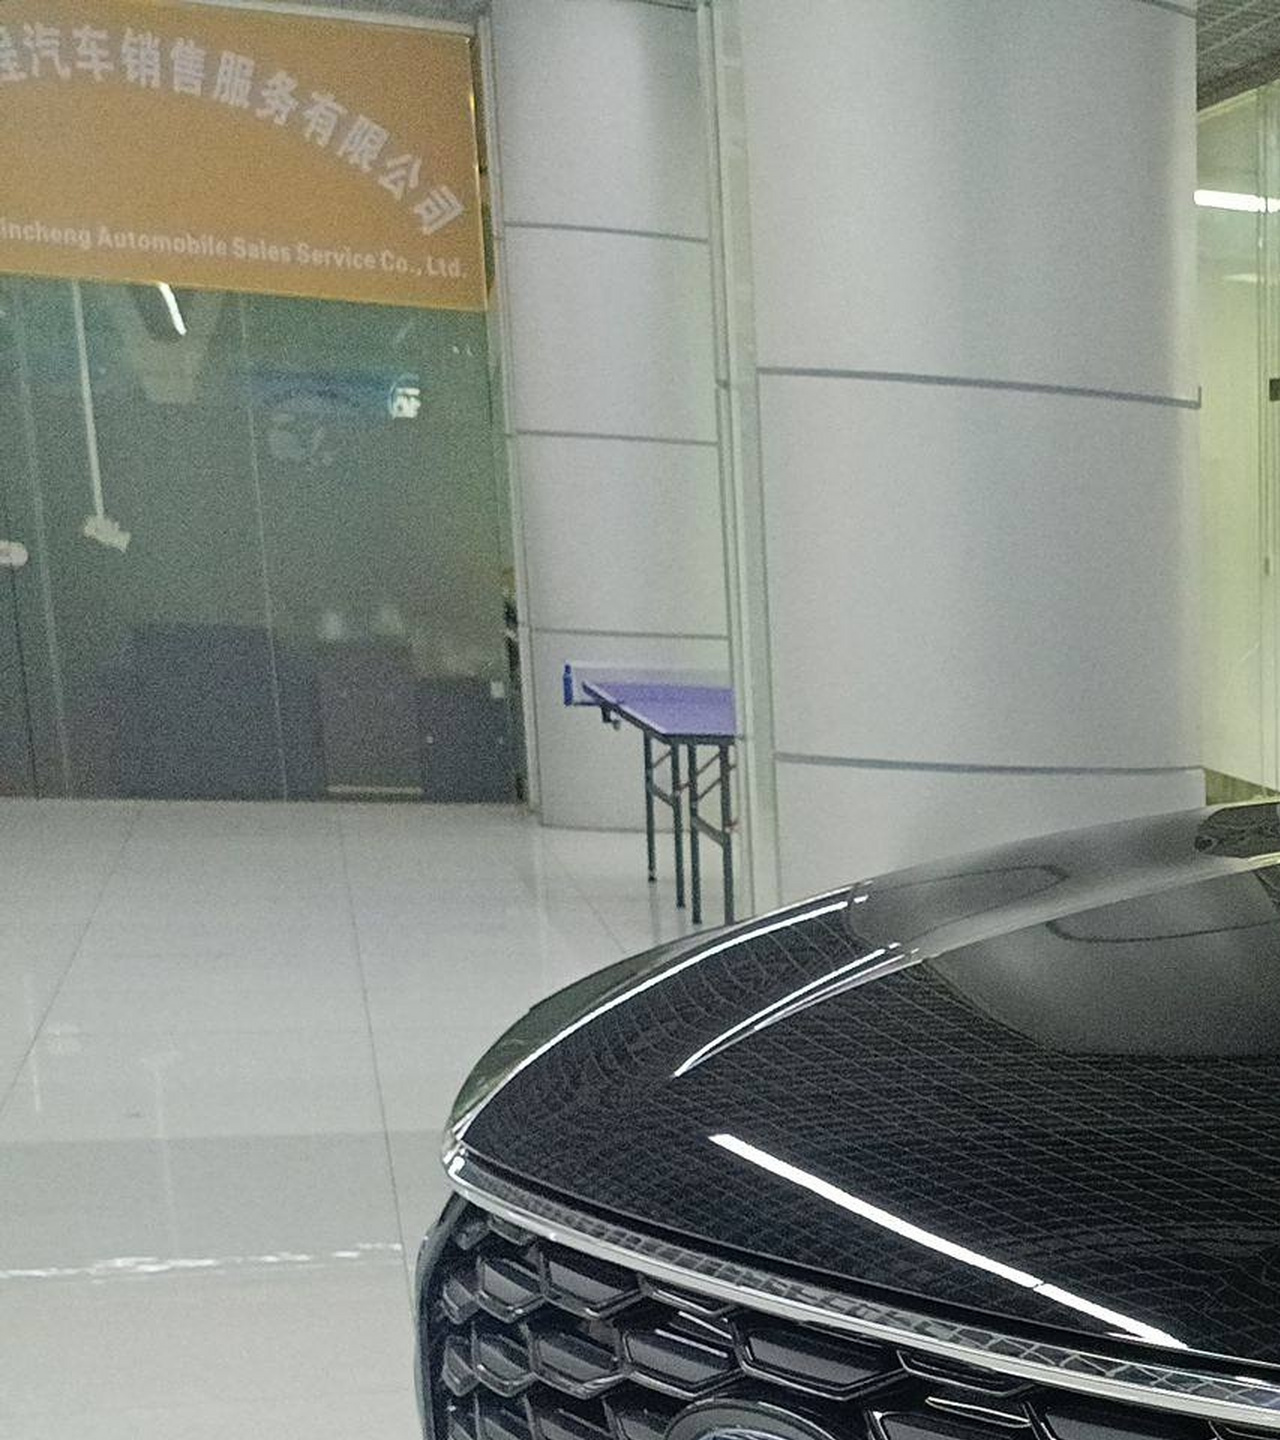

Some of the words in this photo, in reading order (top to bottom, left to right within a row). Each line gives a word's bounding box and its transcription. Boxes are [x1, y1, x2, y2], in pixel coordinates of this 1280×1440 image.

[97, 225, 227, 256] Automobile
[232, 237, 291, 264] Sales
[297, 241, 377, 270] Service
